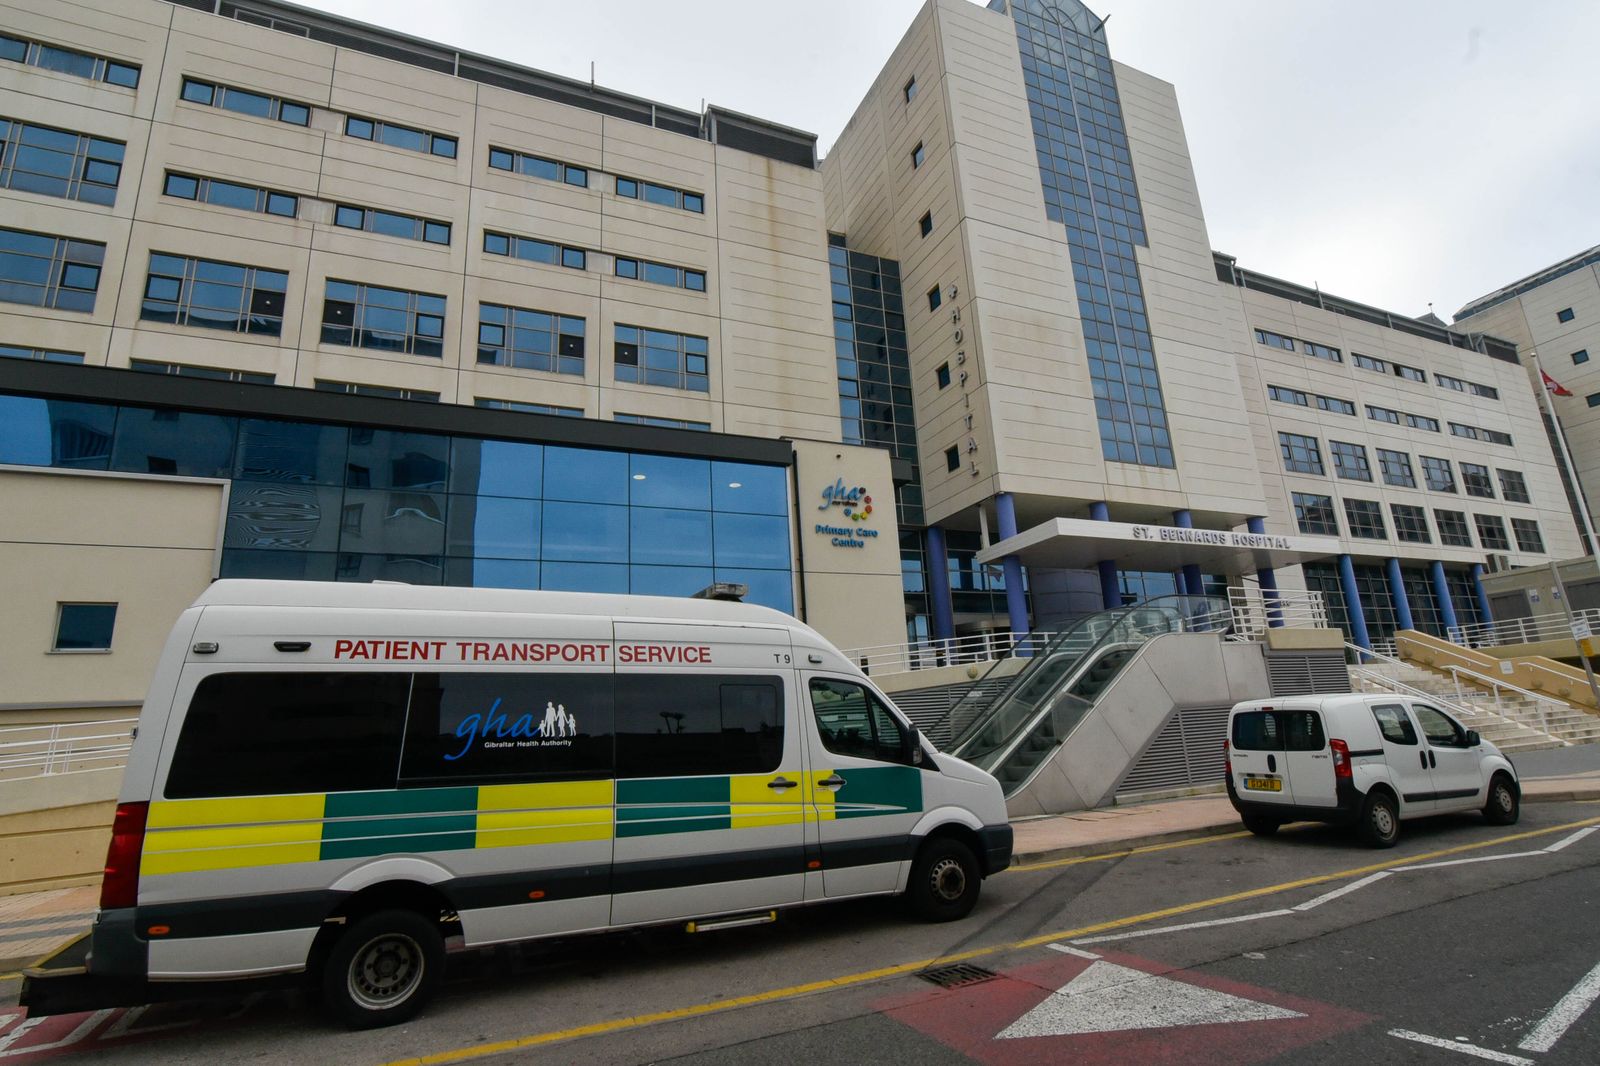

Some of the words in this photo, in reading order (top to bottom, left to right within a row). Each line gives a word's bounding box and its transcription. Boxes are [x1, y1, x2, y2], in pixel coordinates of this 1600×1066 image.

[951, 305, 979, 477] HOSPITAL
[818, 477, 863, 511] gha
[815, 524, 853, 538] Primary
[856, 527, 878, 538] Care
[1133, 526, 1154, 540] ST.
[1160, 528, 1226, 545] BERNARDS
[1232, 534, 1291, 549] HOSPITAL
[831, 537, 865, 549] Centre
[334, 639, 447, 660] PATIENT
[456, 642, 610, 662] TRANSPORT
[619, 645, 712, 663] SERVICE
[443, 697, 541, 760] gha
[484, 741, 515, 749] Gibraltar
[516, 740, 539, 748] Health
[540, 739, 572, 748] Authority
